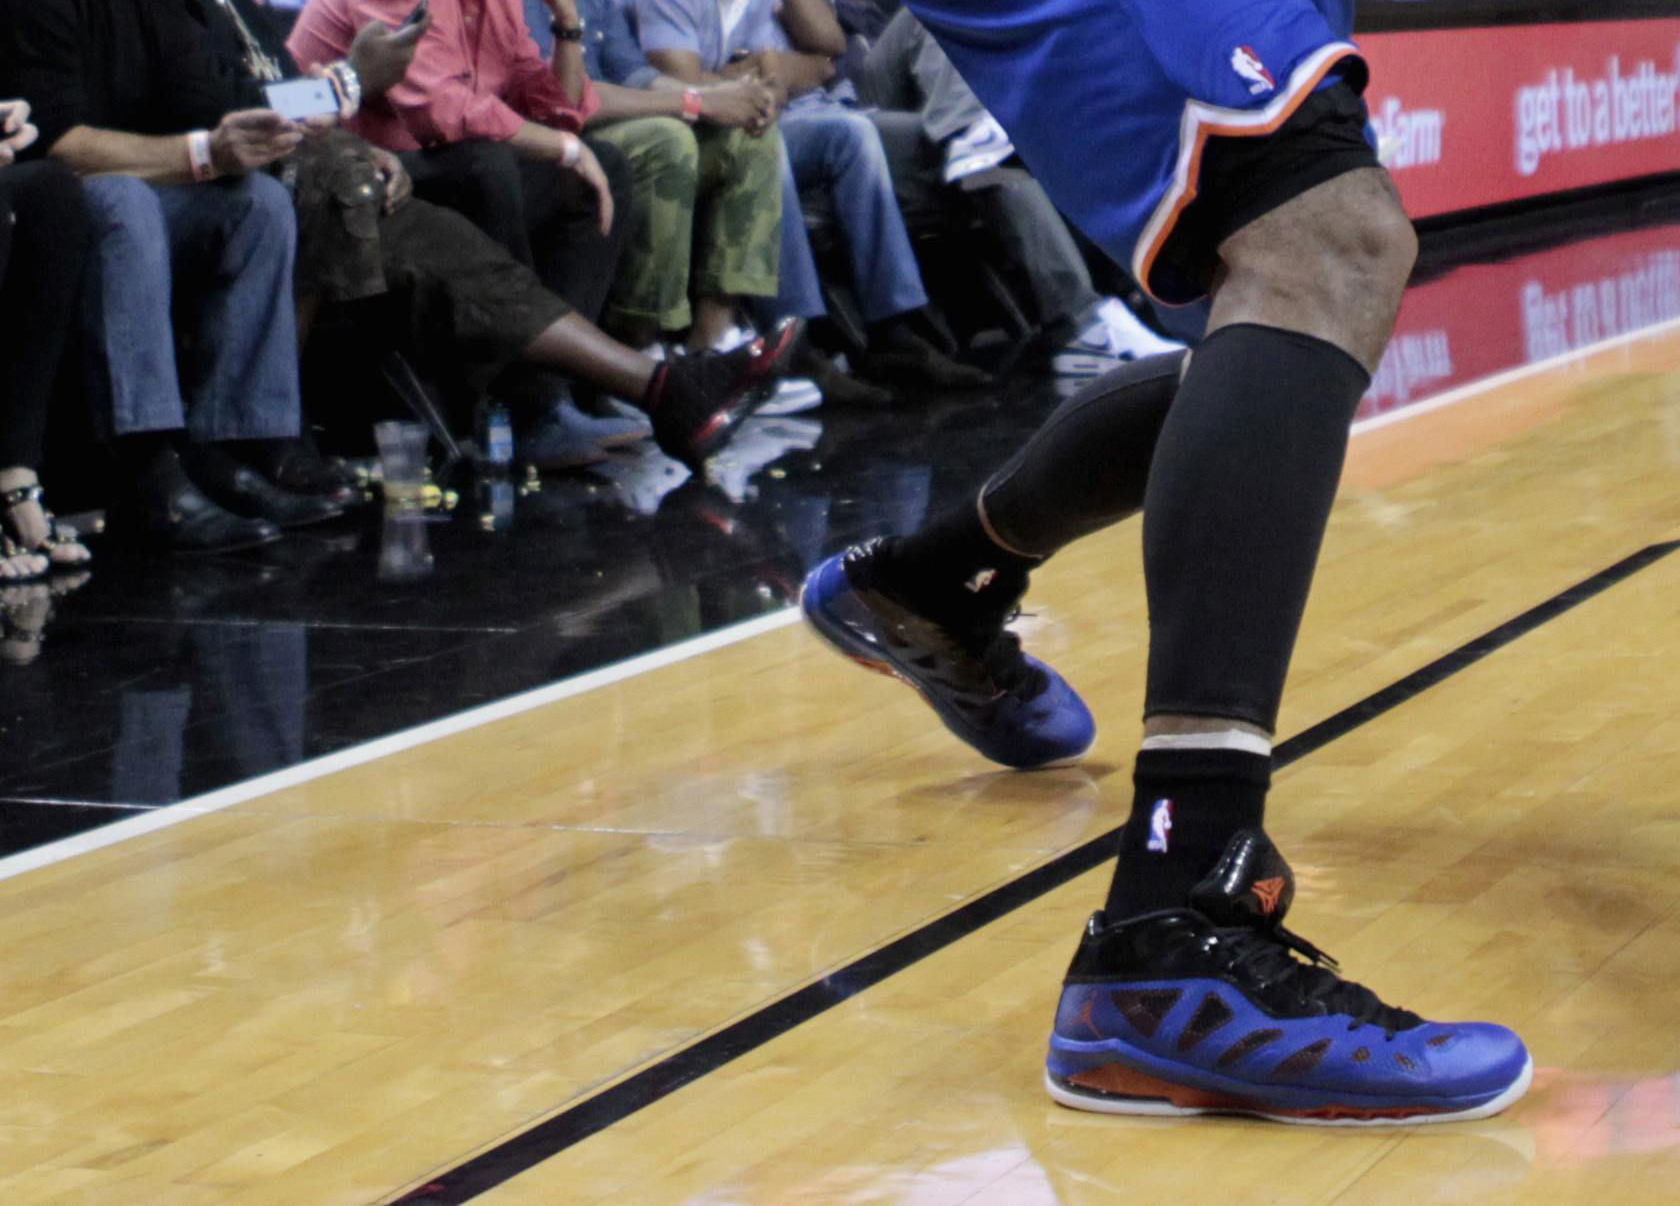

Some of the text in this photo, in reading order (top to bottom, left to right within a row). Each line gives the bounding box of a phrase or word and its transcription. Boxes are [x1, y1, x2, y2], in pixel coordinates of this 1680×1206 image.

[1515, 66, 1562, 176] get
[1563, 65, 1591, 150] to
[1611, 55, 1677, 142] better
